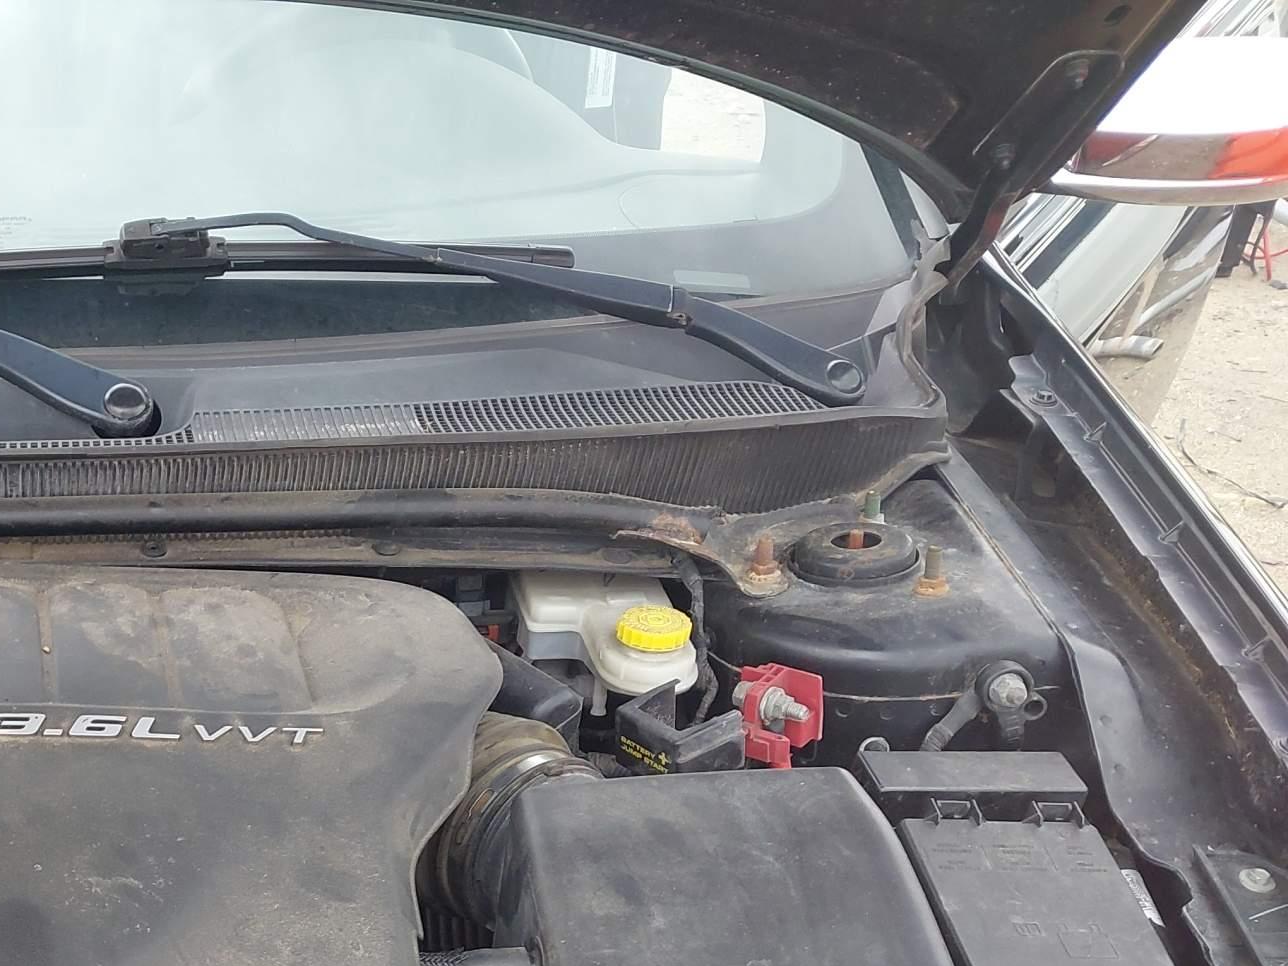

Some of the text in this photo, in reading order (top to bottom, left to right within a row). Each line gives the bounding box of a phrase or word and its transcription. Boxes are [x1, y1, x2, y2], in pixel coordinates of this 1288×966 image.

[194, 723, 325, 746] VVT
[620, 736, 656, 759] BATTERY
[620, 744, 669, 774] JUMP START
